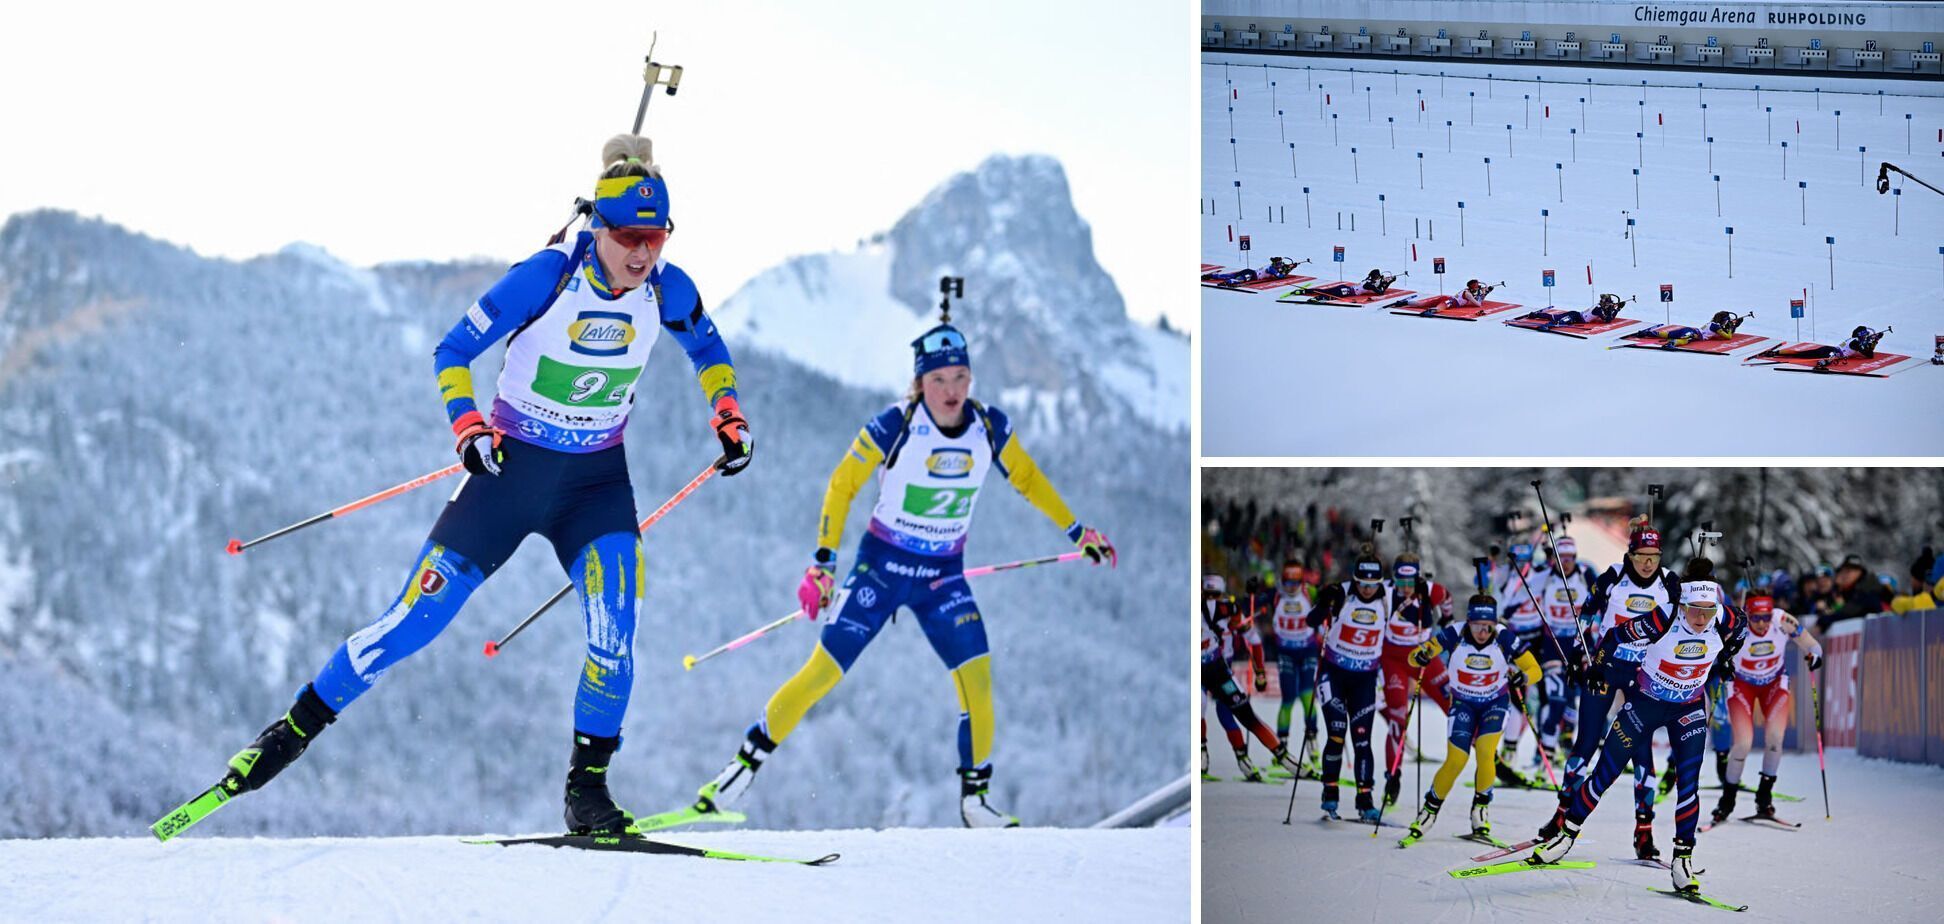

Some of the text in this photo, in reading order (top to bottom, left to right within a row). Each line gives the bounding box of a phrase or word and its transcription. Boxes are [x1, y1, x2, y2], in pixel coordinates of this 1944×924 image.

[1634, 6, 1756, 26] Chiemgau Arena
[1768, 12, 1867, 25] RUHPOLDING
[1612, 33, 1620, 43] 17
[1659, 35, 1667, 44] 16
[1708, 37, 1717, 46] 15
[1759, 38, 1767, 48] 14
[1811, 39, 1820, 49] 13
[1866, 40, 1876, 50] 12
[1923, 42, 1932, 52] 11
[1242, 241, 1248, 250] 6
[1337, 253, 1342, 261] 5
[1437, 264, 1443, 273] 4
[1547, 277, 1553, 286] 3
[1664, 291, 1670, 301] 2
[1796, 307, 1801, 316] 1
[568, 370, 608, 402] 9
[924, 490, 968, 515] 2 2
[423, 573, 438, 591] 1
[1352, 629, 1377, 645] 5 1
[1675, 666, 1697, 679] 3
[1470, 674, 1486, 685] 2
[1680, 726, 1705, 741] CRAFT
